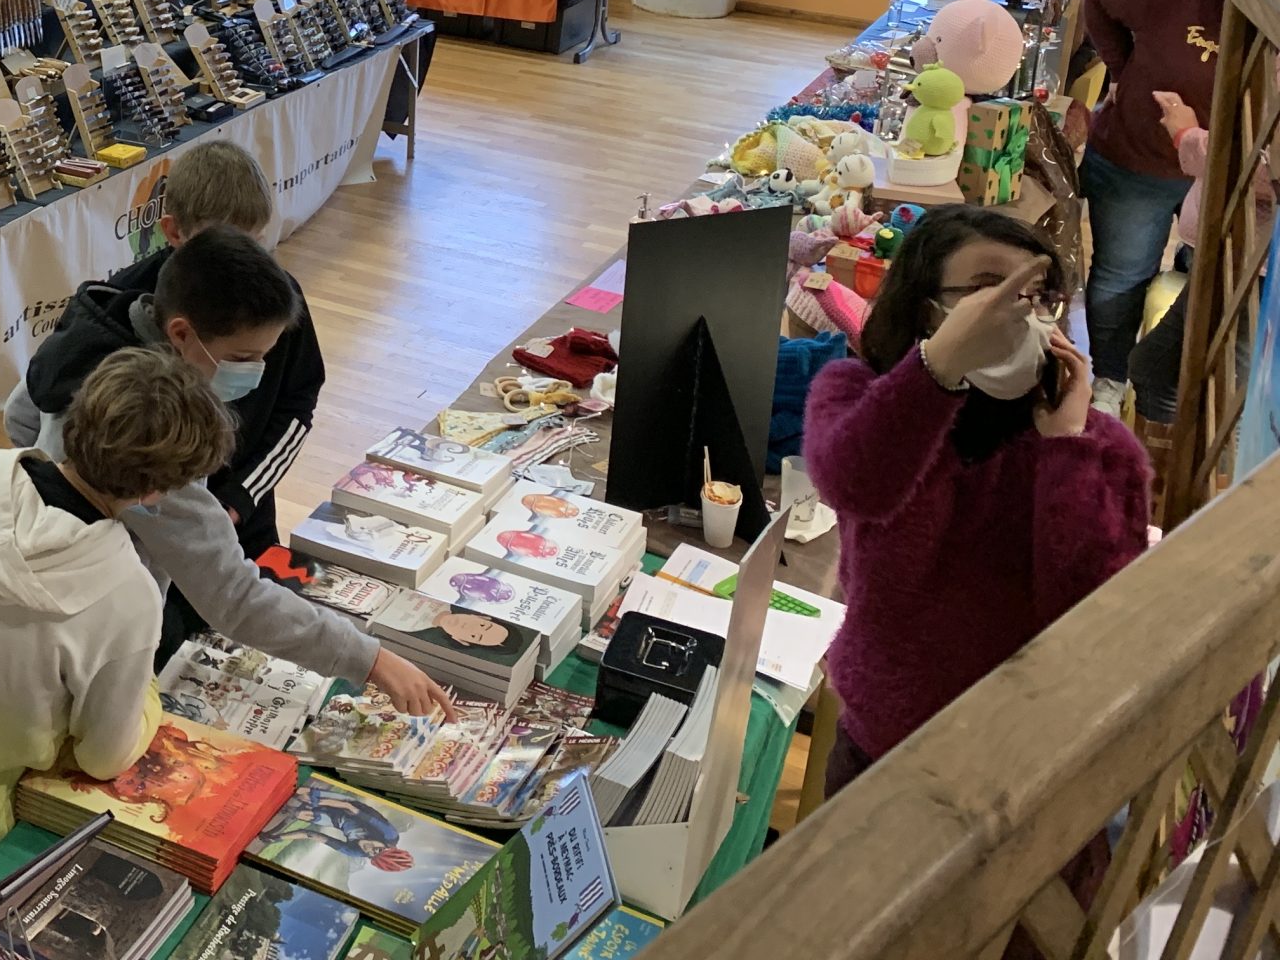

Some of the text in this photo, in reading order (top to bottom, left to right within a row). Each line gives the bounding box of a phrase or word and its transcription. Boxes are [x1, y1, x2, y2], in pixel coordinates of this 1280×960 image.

[3, 295, 72, 344] artisa
[32, 316, 60, 338] Cou
[335, 580, 362, 598] Song
[348, 582, 380, 607] Datura
[568, 826, 577, 843] DU
[22, 863, 84, 924] Limoges Souterrain
[231, 888, 257, 916] Prestige
[225, 914, 237, 925] de
